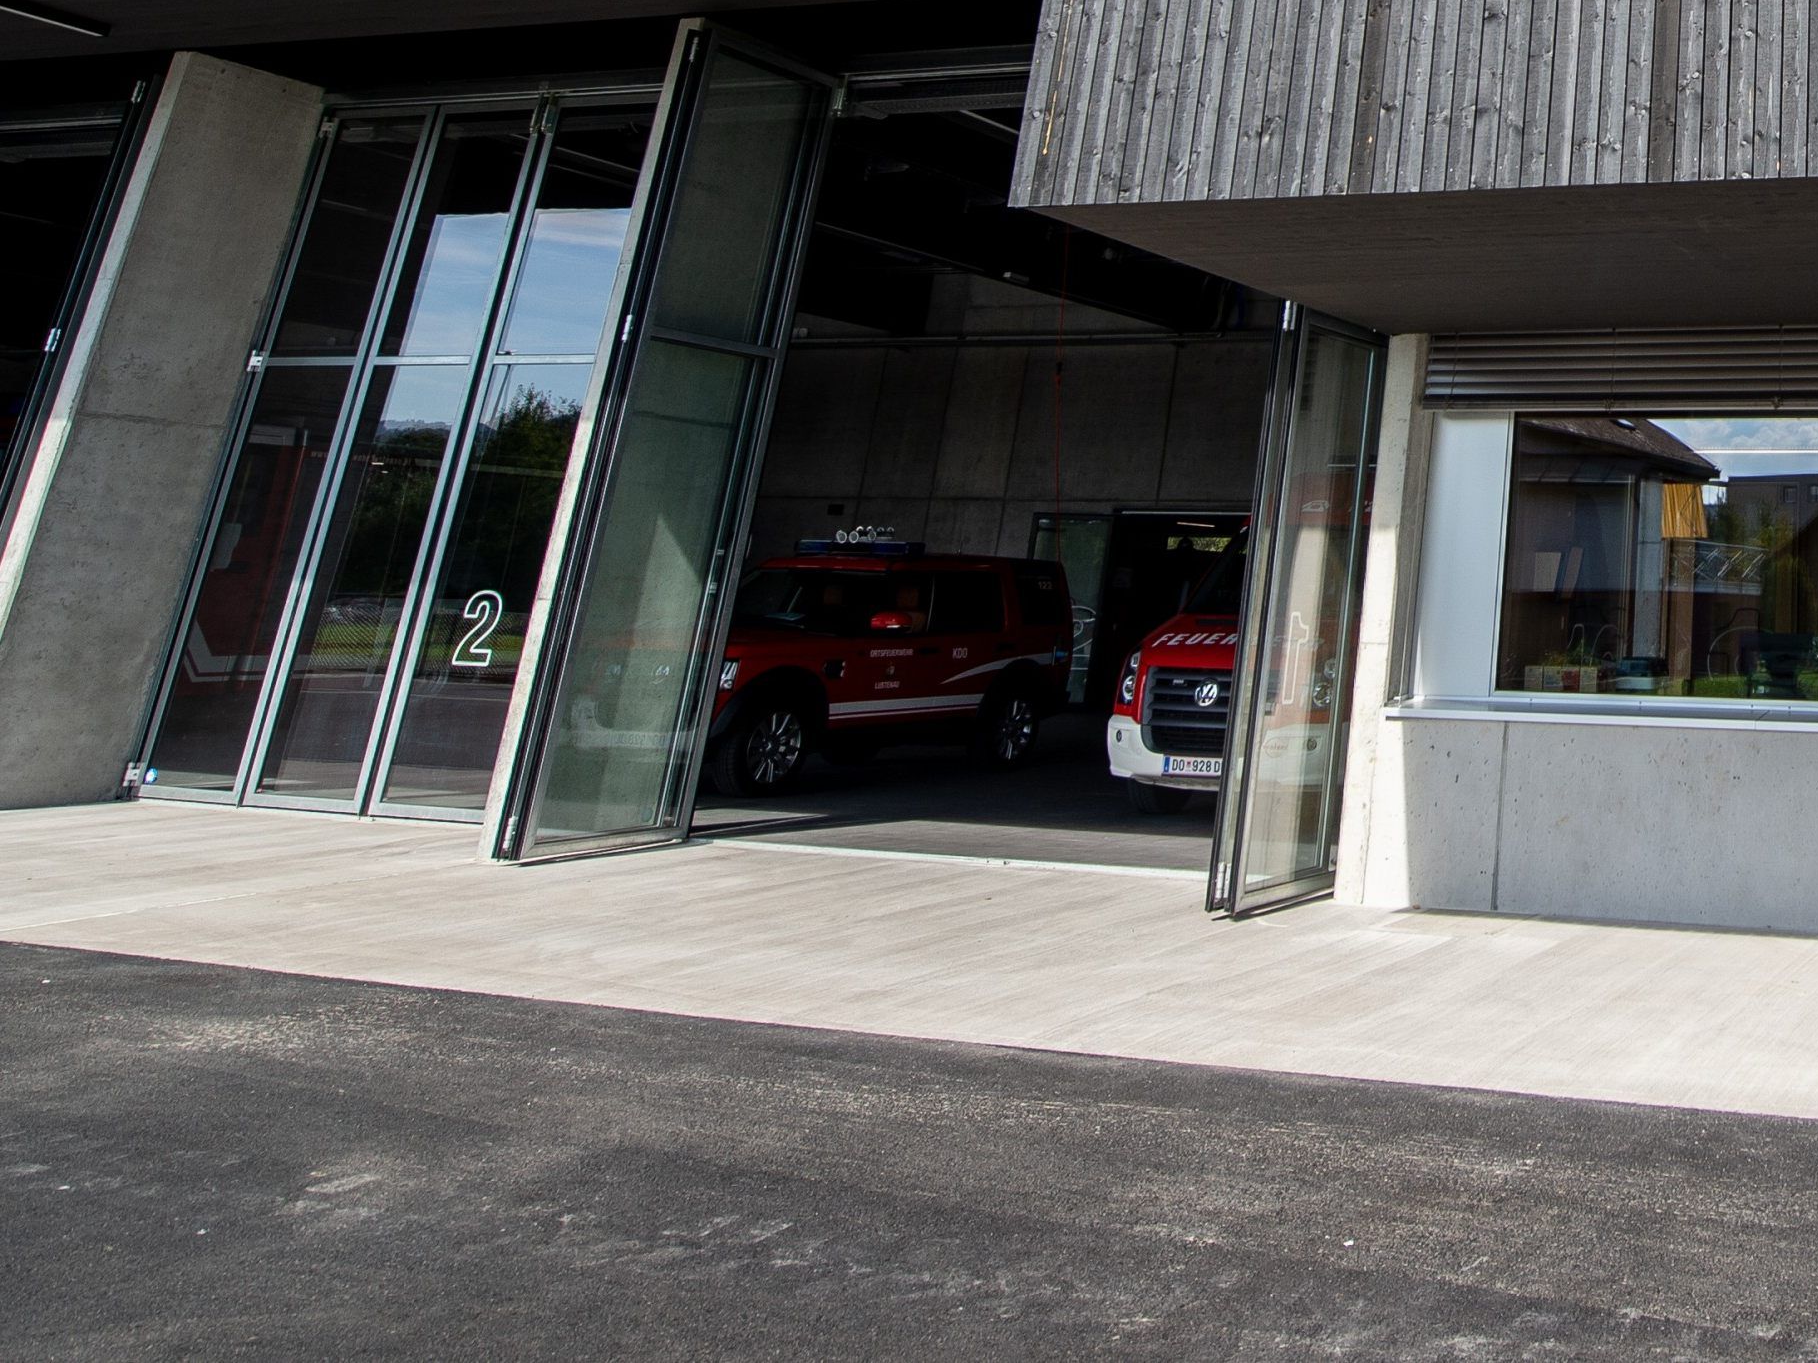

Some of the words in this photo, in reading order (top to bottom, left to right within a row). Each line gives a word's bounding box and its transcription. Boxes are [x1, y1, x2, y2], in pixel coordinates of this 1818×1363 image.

[452, 589, 503, 667] 2
[1192, 759, 1212, 773] 928
[1213, 760, 1221, 773] D
